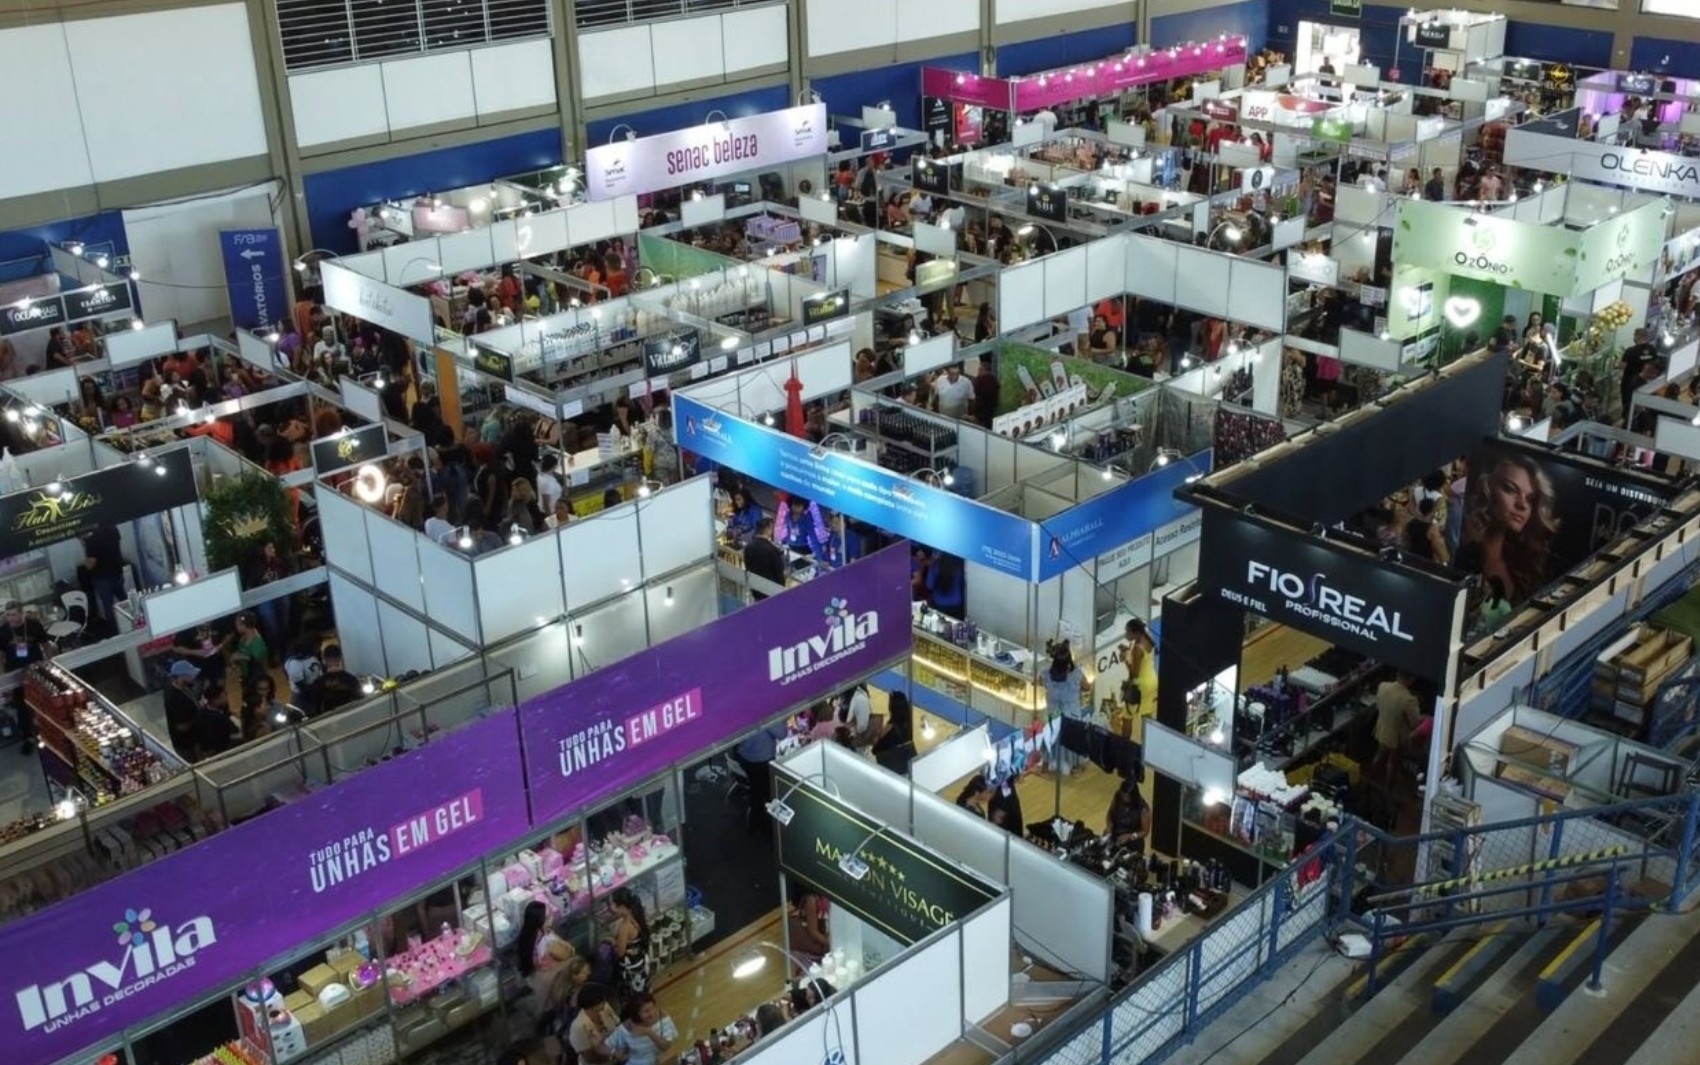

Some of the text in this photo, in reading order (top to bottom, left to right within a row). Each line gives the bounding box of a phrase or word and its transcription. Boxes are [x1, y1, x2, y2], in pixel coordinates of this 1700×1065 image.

[667, 132, 759, 175] senac beleza
[1600, 153, 1699, 184] OLENKA
[1220, 587, 1268, 613] DEUS E FIEL
[1246, 560, 1414, 641] FIO REAL
[1284, 600, 1377, 641] PROFISSIONAL
[768, 611, 879, 682] Invila
[813, 641, 867, 671] DECORADAS
[559, 693, 696, 777] UNHAS EM GEL
[559, 719, 613, 752] TUDO PARA
[308, 827, 375, 866] TUDO PARA
[310, 796, 477, 894] UNHAS EM GEL
[14, 915, 217, 1032] Invila
[42, 956, 197, 1034] UNHAS DECORADAS
